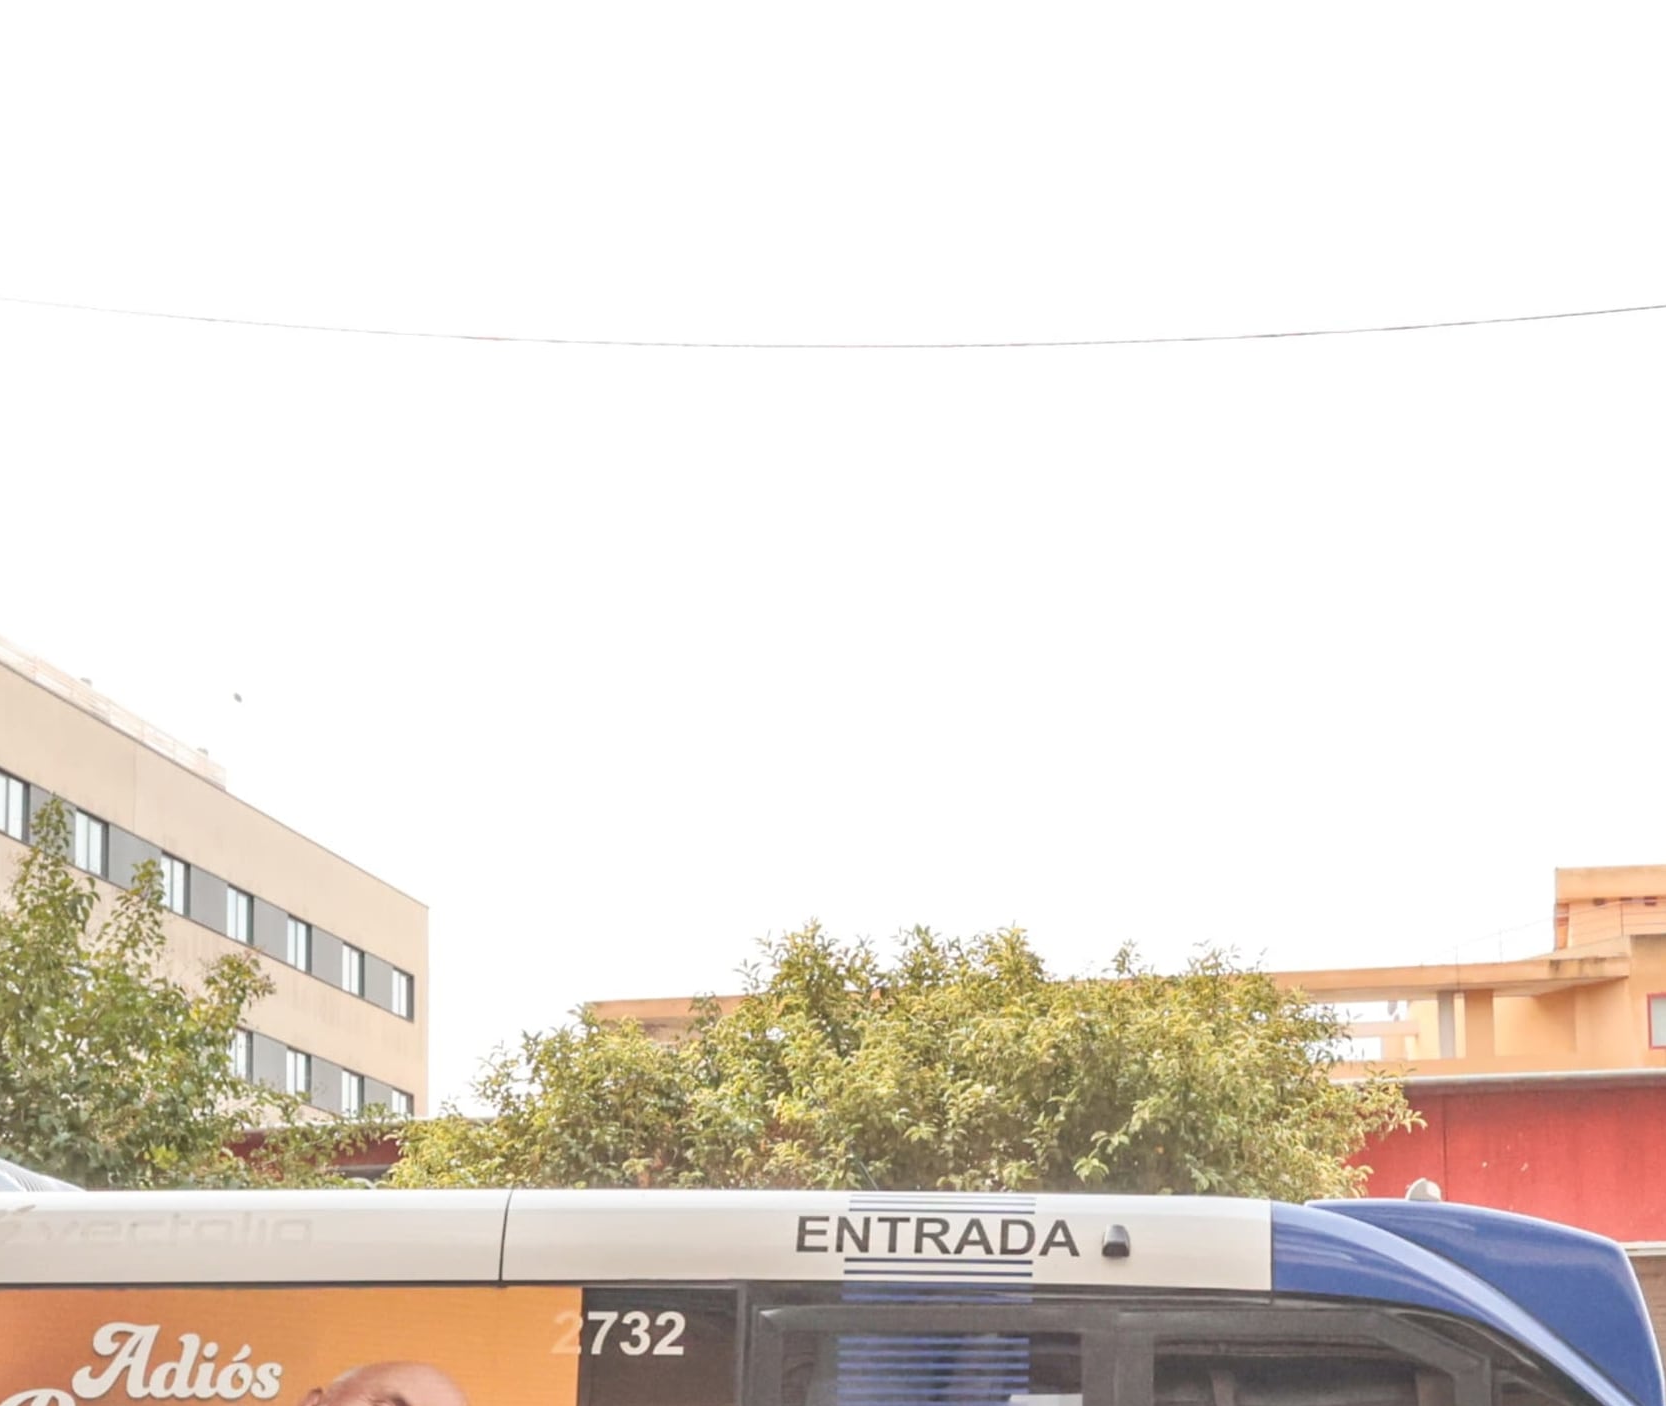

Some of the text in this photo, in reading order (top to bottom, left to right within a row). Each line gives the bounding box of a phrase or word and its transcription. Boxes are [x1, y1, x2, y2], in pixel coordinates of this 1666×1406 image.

[796, 1215, 1081, 1257] ENTRADA
[550, 1311, 686, 1356] 2732
[72, 1322, 283, 1399] Adiós
